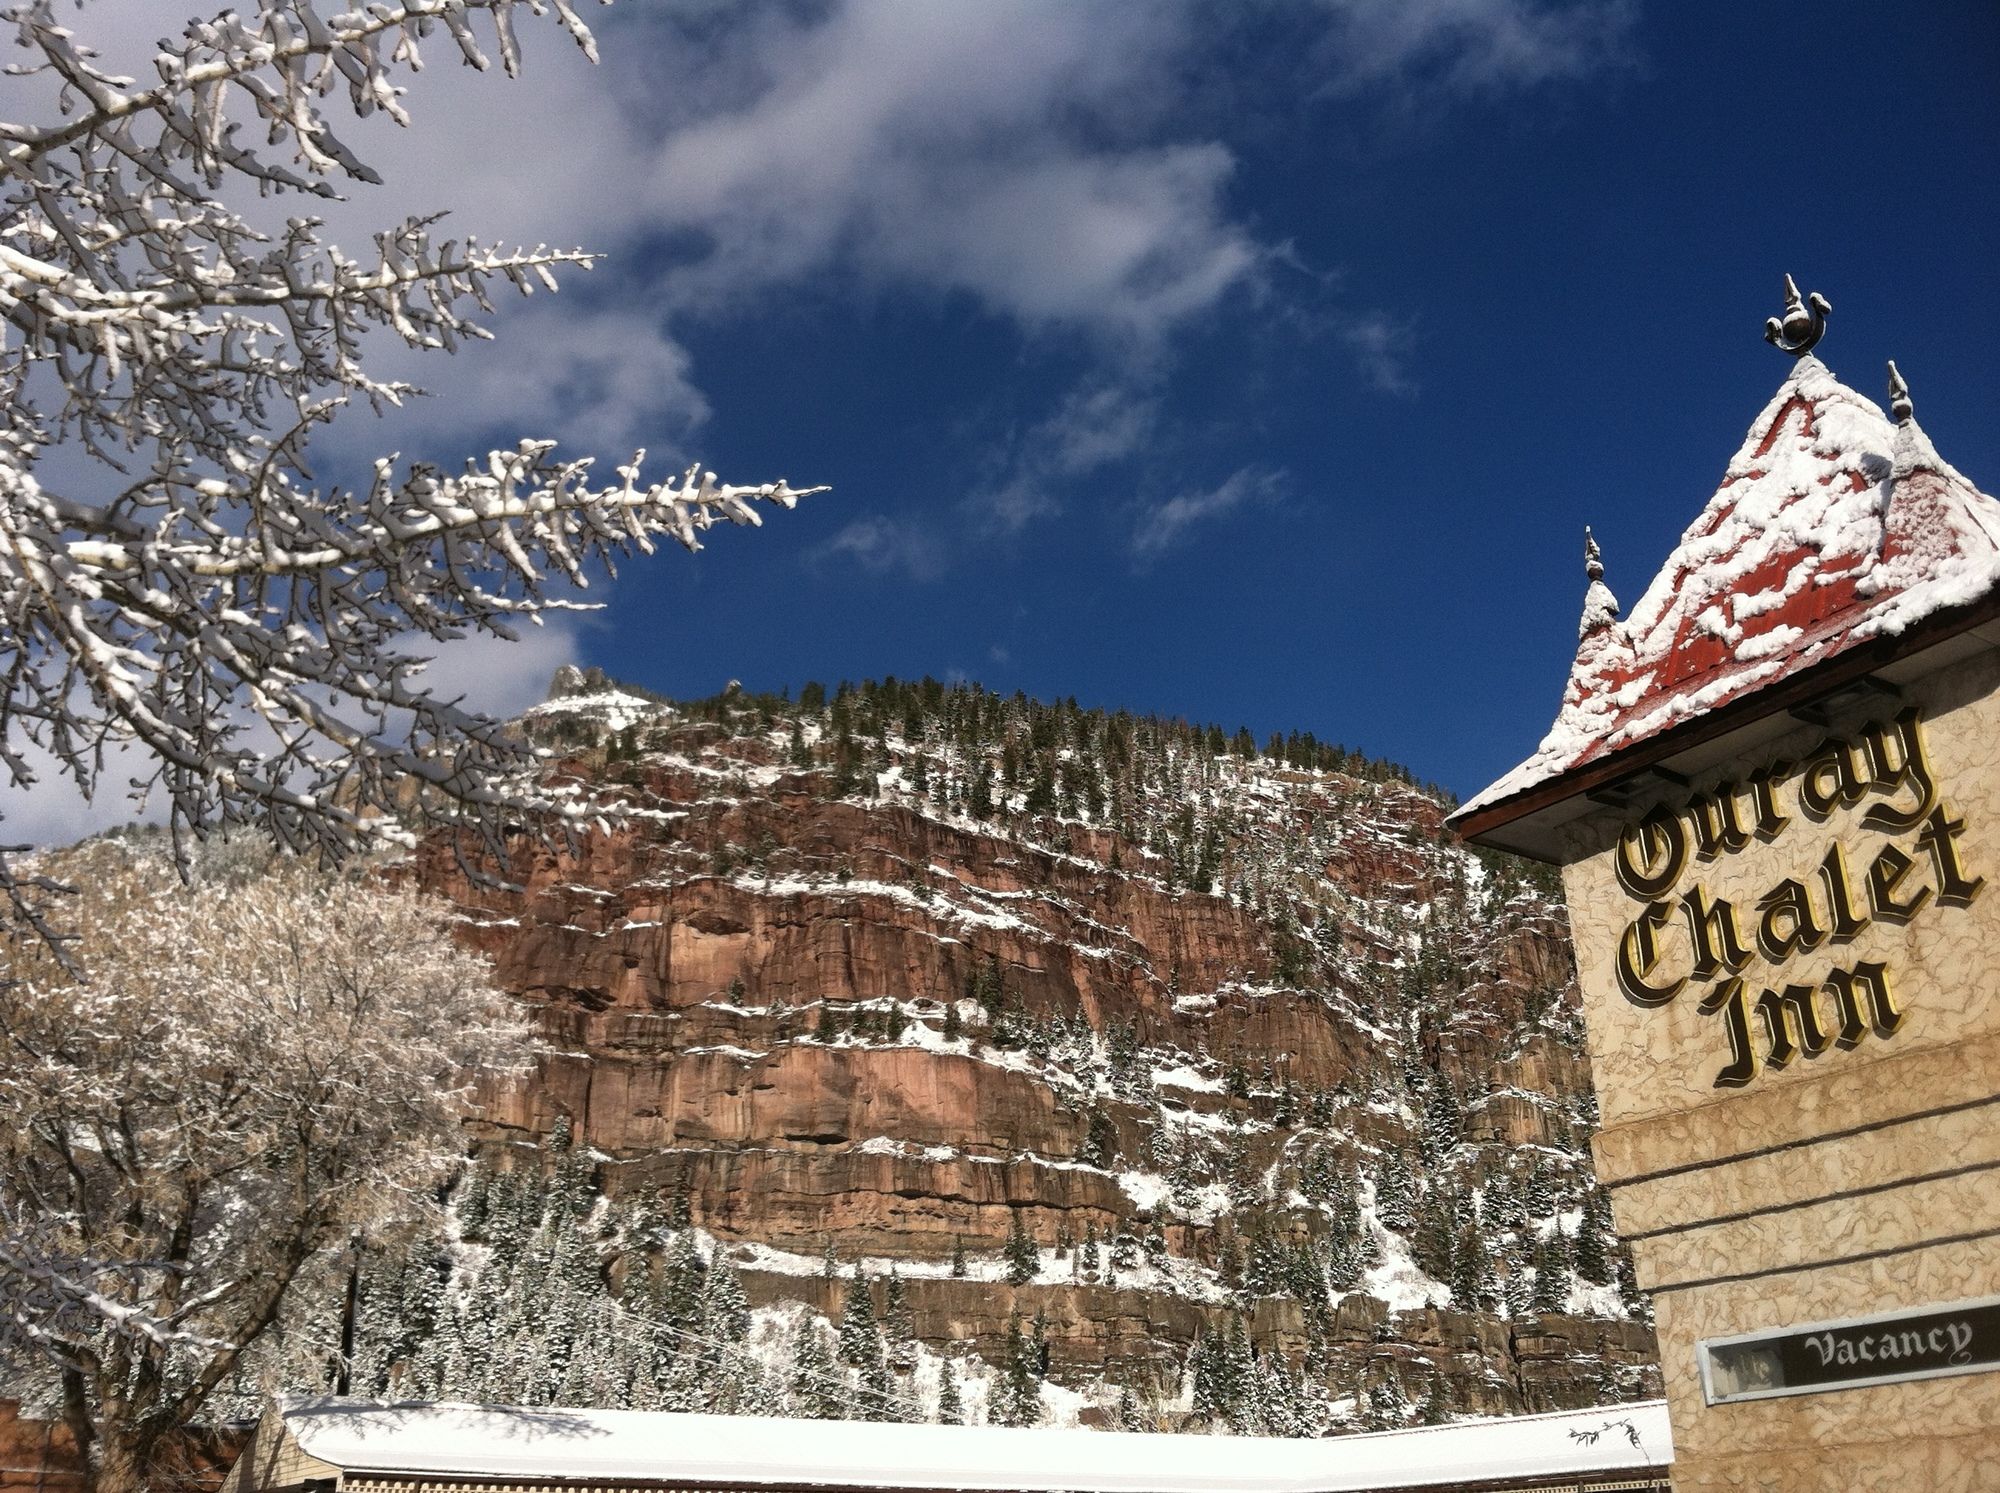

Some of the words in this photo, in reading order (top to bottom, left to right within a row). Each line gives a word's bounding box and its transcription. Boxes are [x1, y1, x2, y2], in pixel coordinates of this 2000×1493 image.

[1615, 706, 1937, 900] Ouray
[1616, 803, 1987, 1008] Chalet
[1697, 961, 1902, 1088] Inn
[1804, 1321, 1973, 1367] Vacancy
